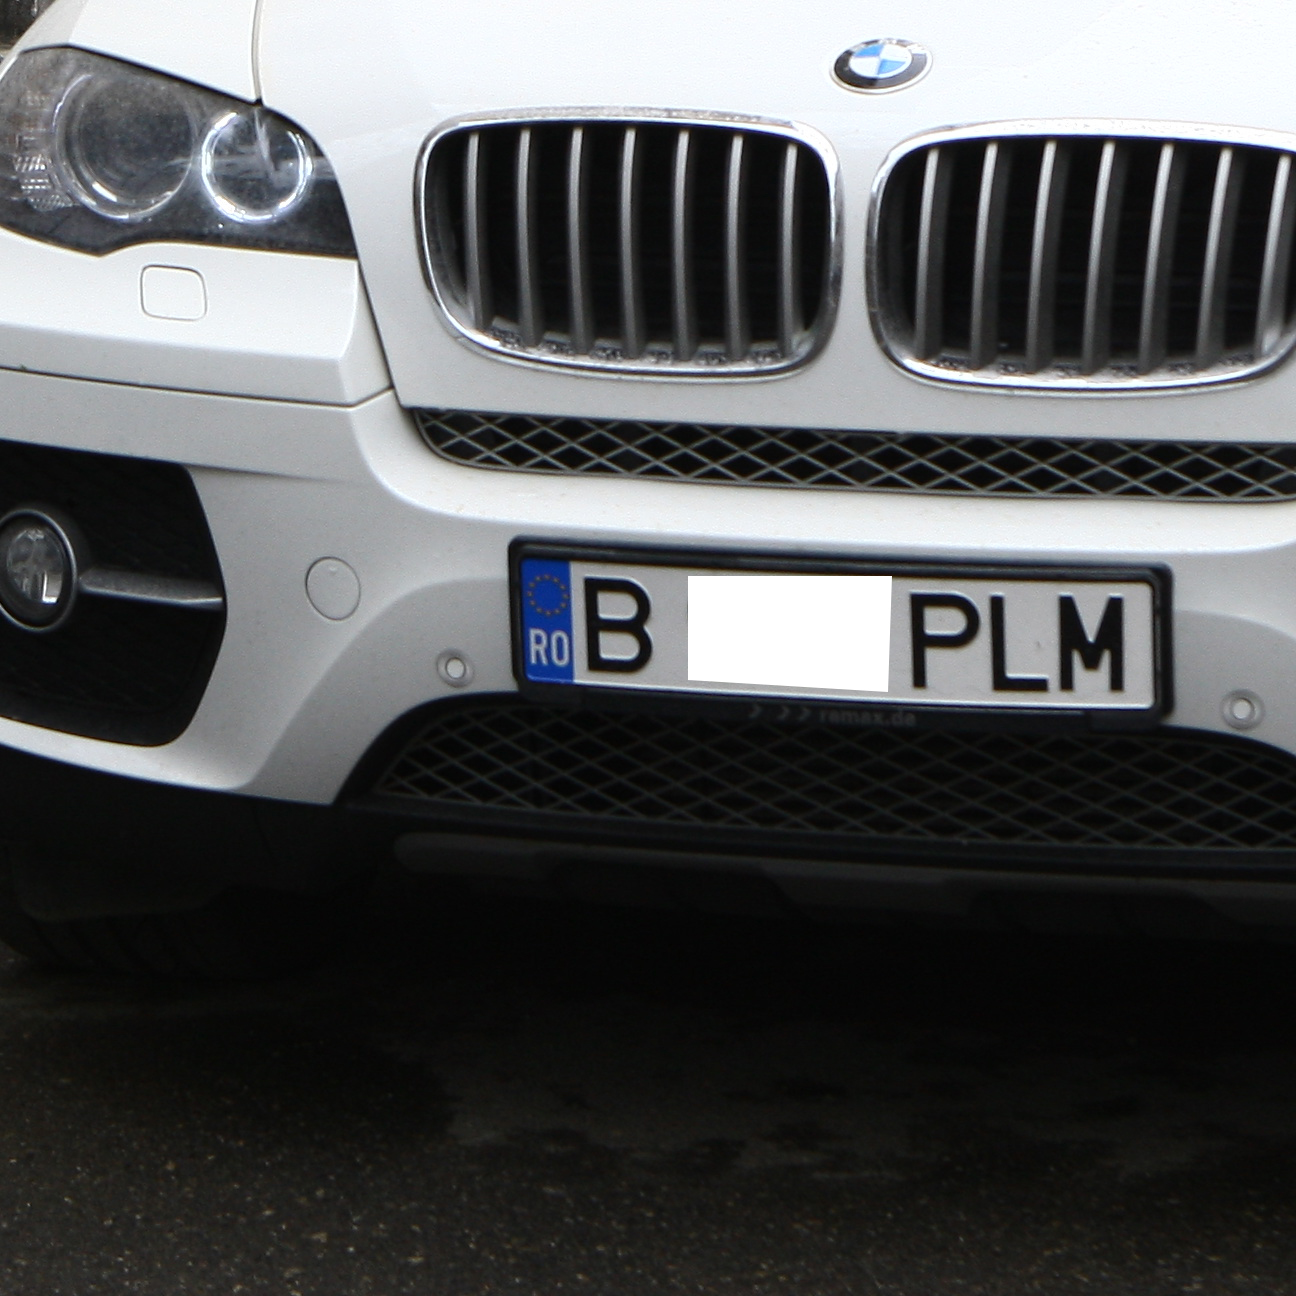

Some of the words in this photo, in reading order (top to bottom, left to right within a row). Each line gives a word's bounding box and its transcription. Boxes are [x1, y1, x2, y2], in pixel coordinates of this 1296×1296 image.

[528, 627, 570, 667] RO
[584, 576, 653, 673] B
[909, 591, 1125, 693] PLM
